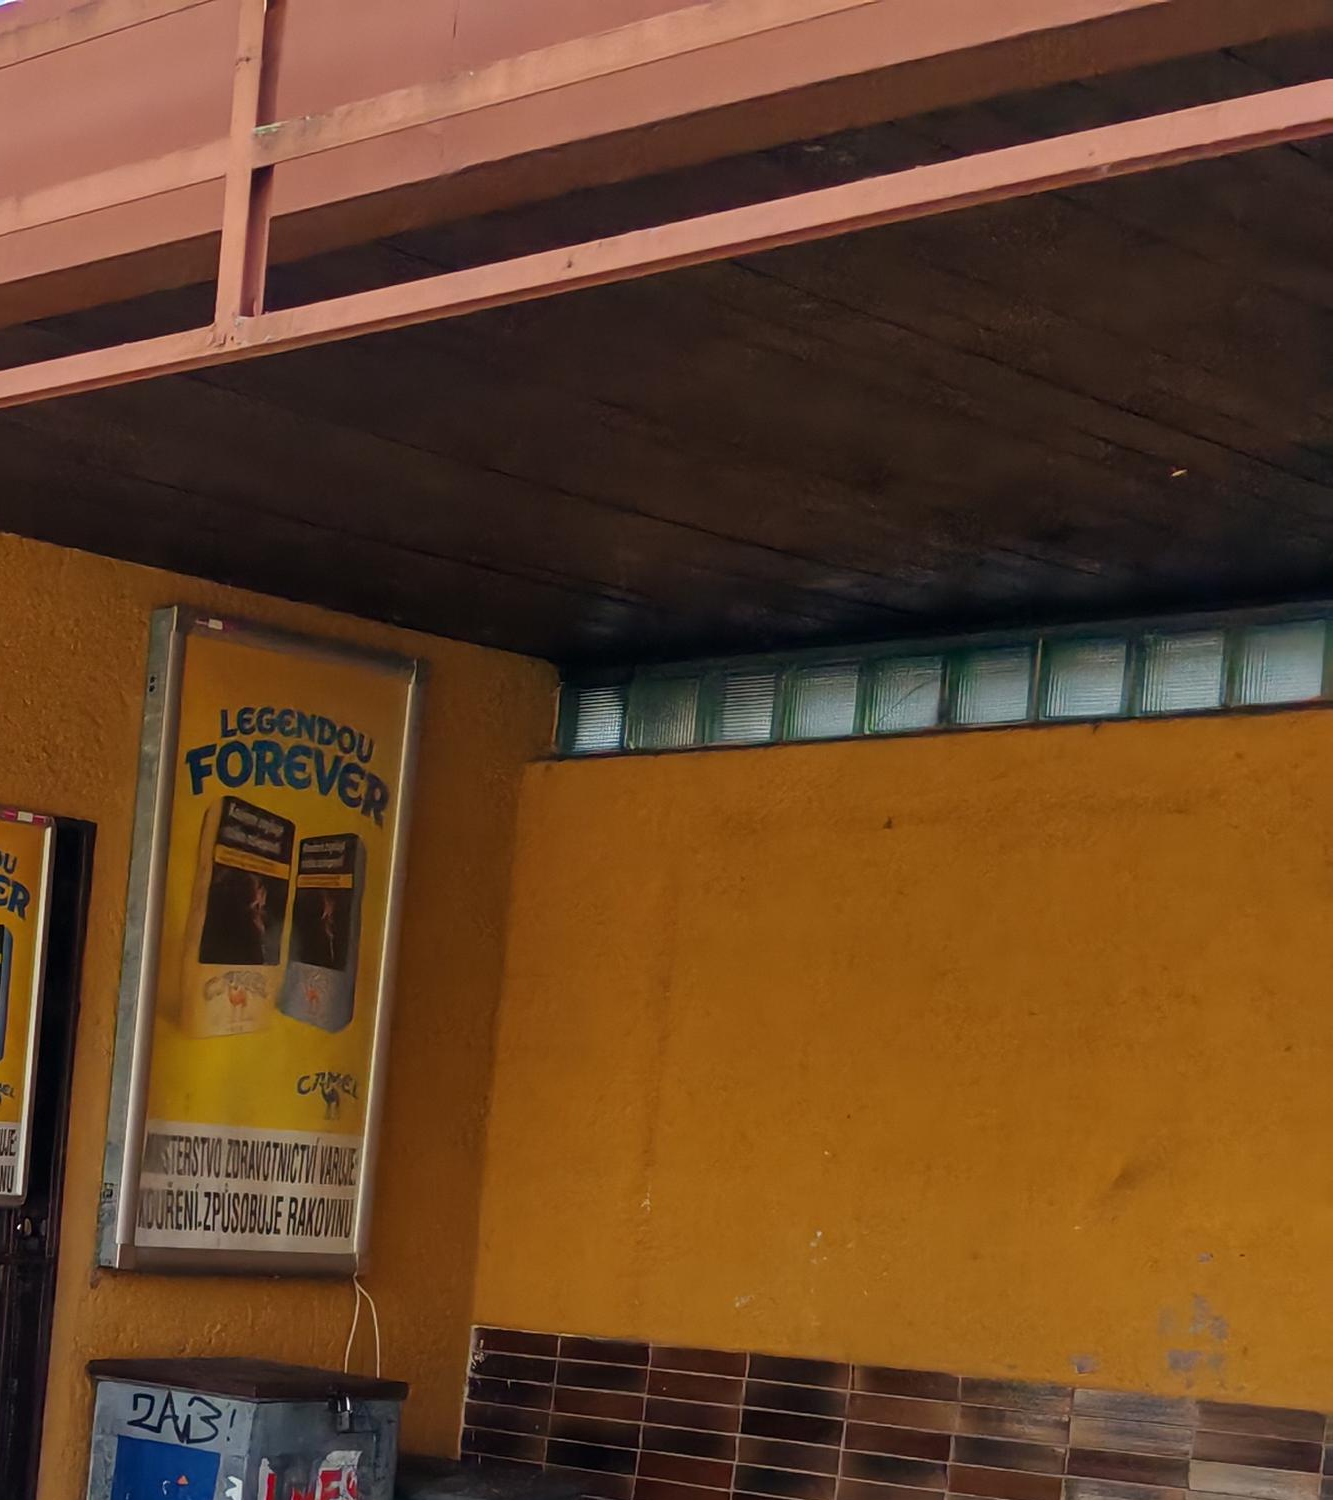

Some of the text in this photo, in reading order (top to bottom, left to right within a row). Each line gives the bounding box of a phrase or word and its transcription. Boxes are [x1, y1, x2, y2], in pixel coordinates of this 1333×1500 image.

[220, 706, 374, 763] LEGENDOU
[186, 740, 390, 829] FOREVER
[225, 1137, 320, 1185] ZDRAVOTNICTVÍ
[204, 1183, 283, 1235] ZPŮSOBUJE
[286, 1196, 354, 1239] RAKOVINU
